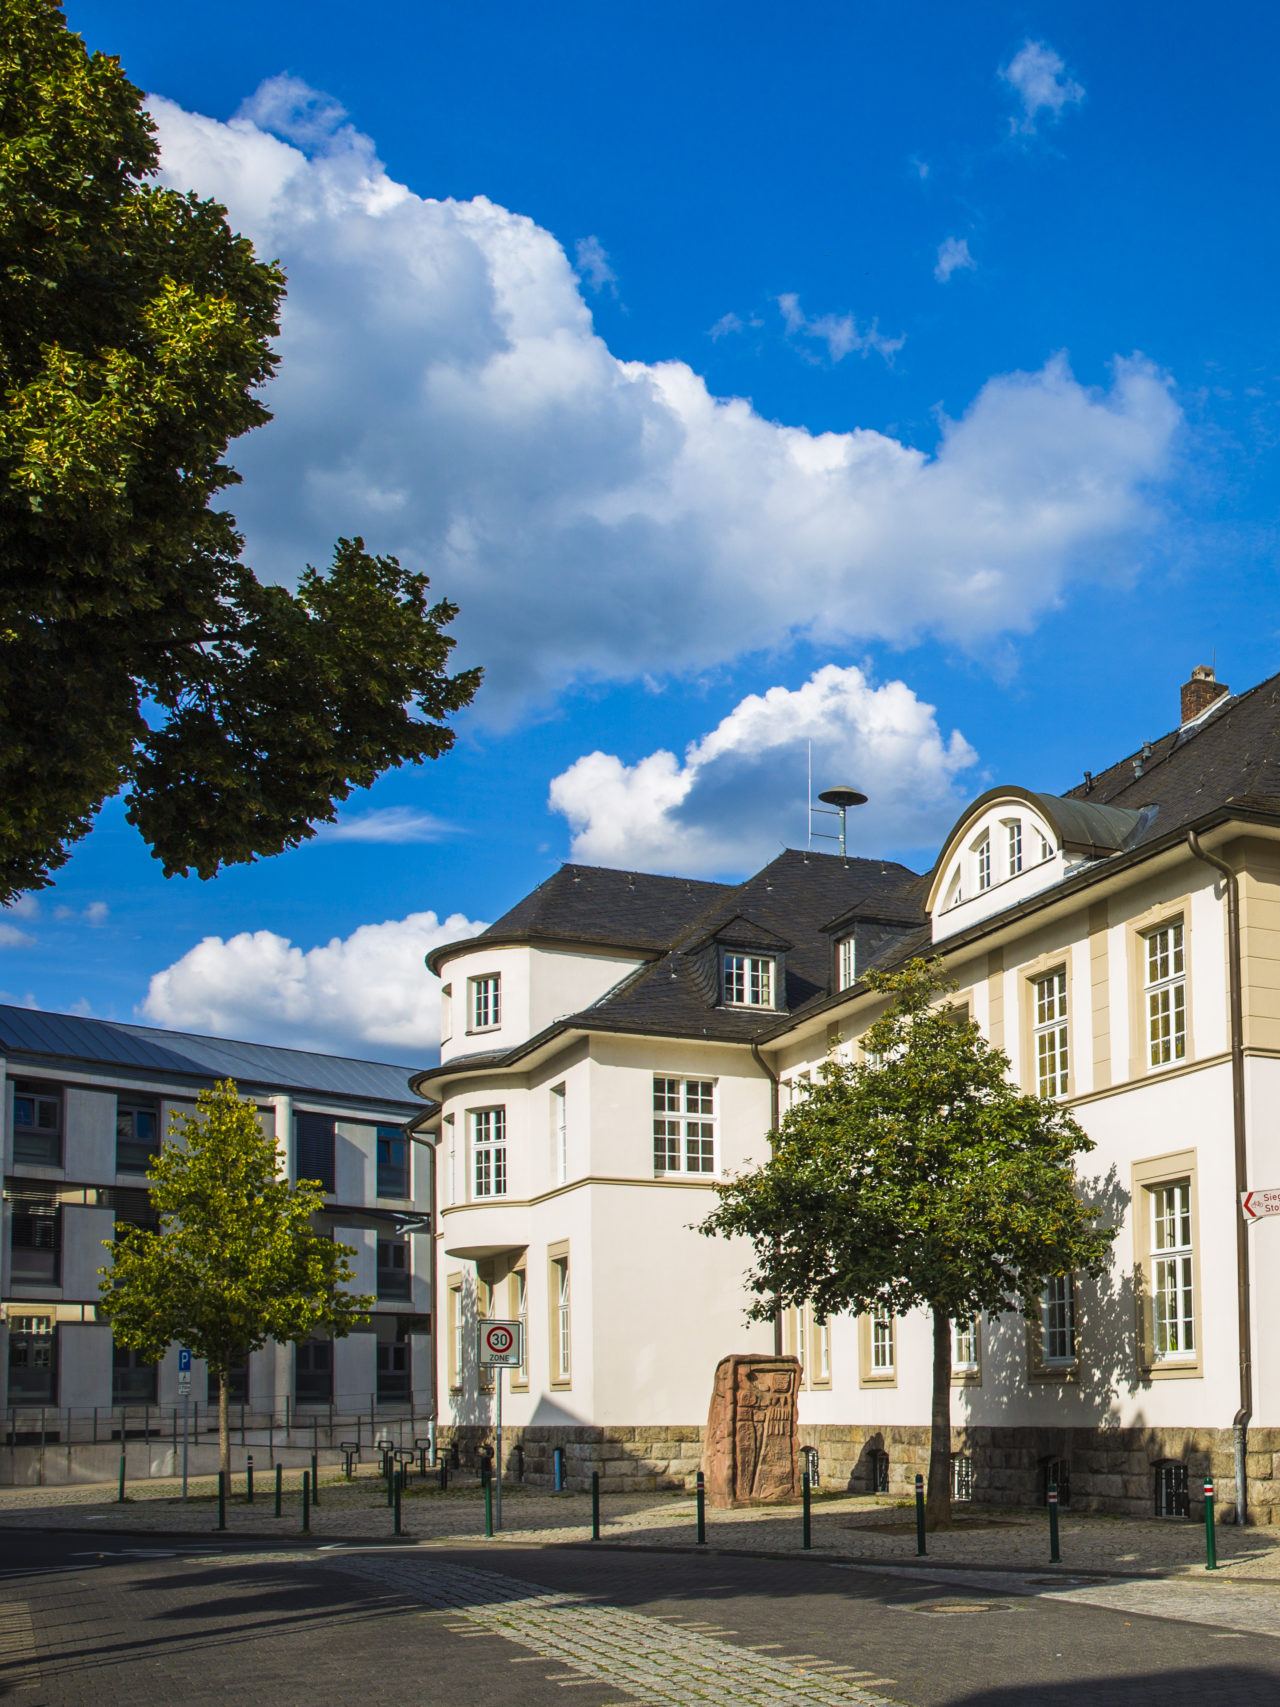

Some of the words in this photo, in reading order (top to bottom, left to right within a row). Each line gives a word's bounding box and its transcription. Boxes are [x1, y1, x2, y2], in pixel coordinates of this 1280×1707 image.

[492, 1333, 508, 1346] 30
[181, 1352, 189, 1368] P
[489, 1354, 510, 1362] ZONE
